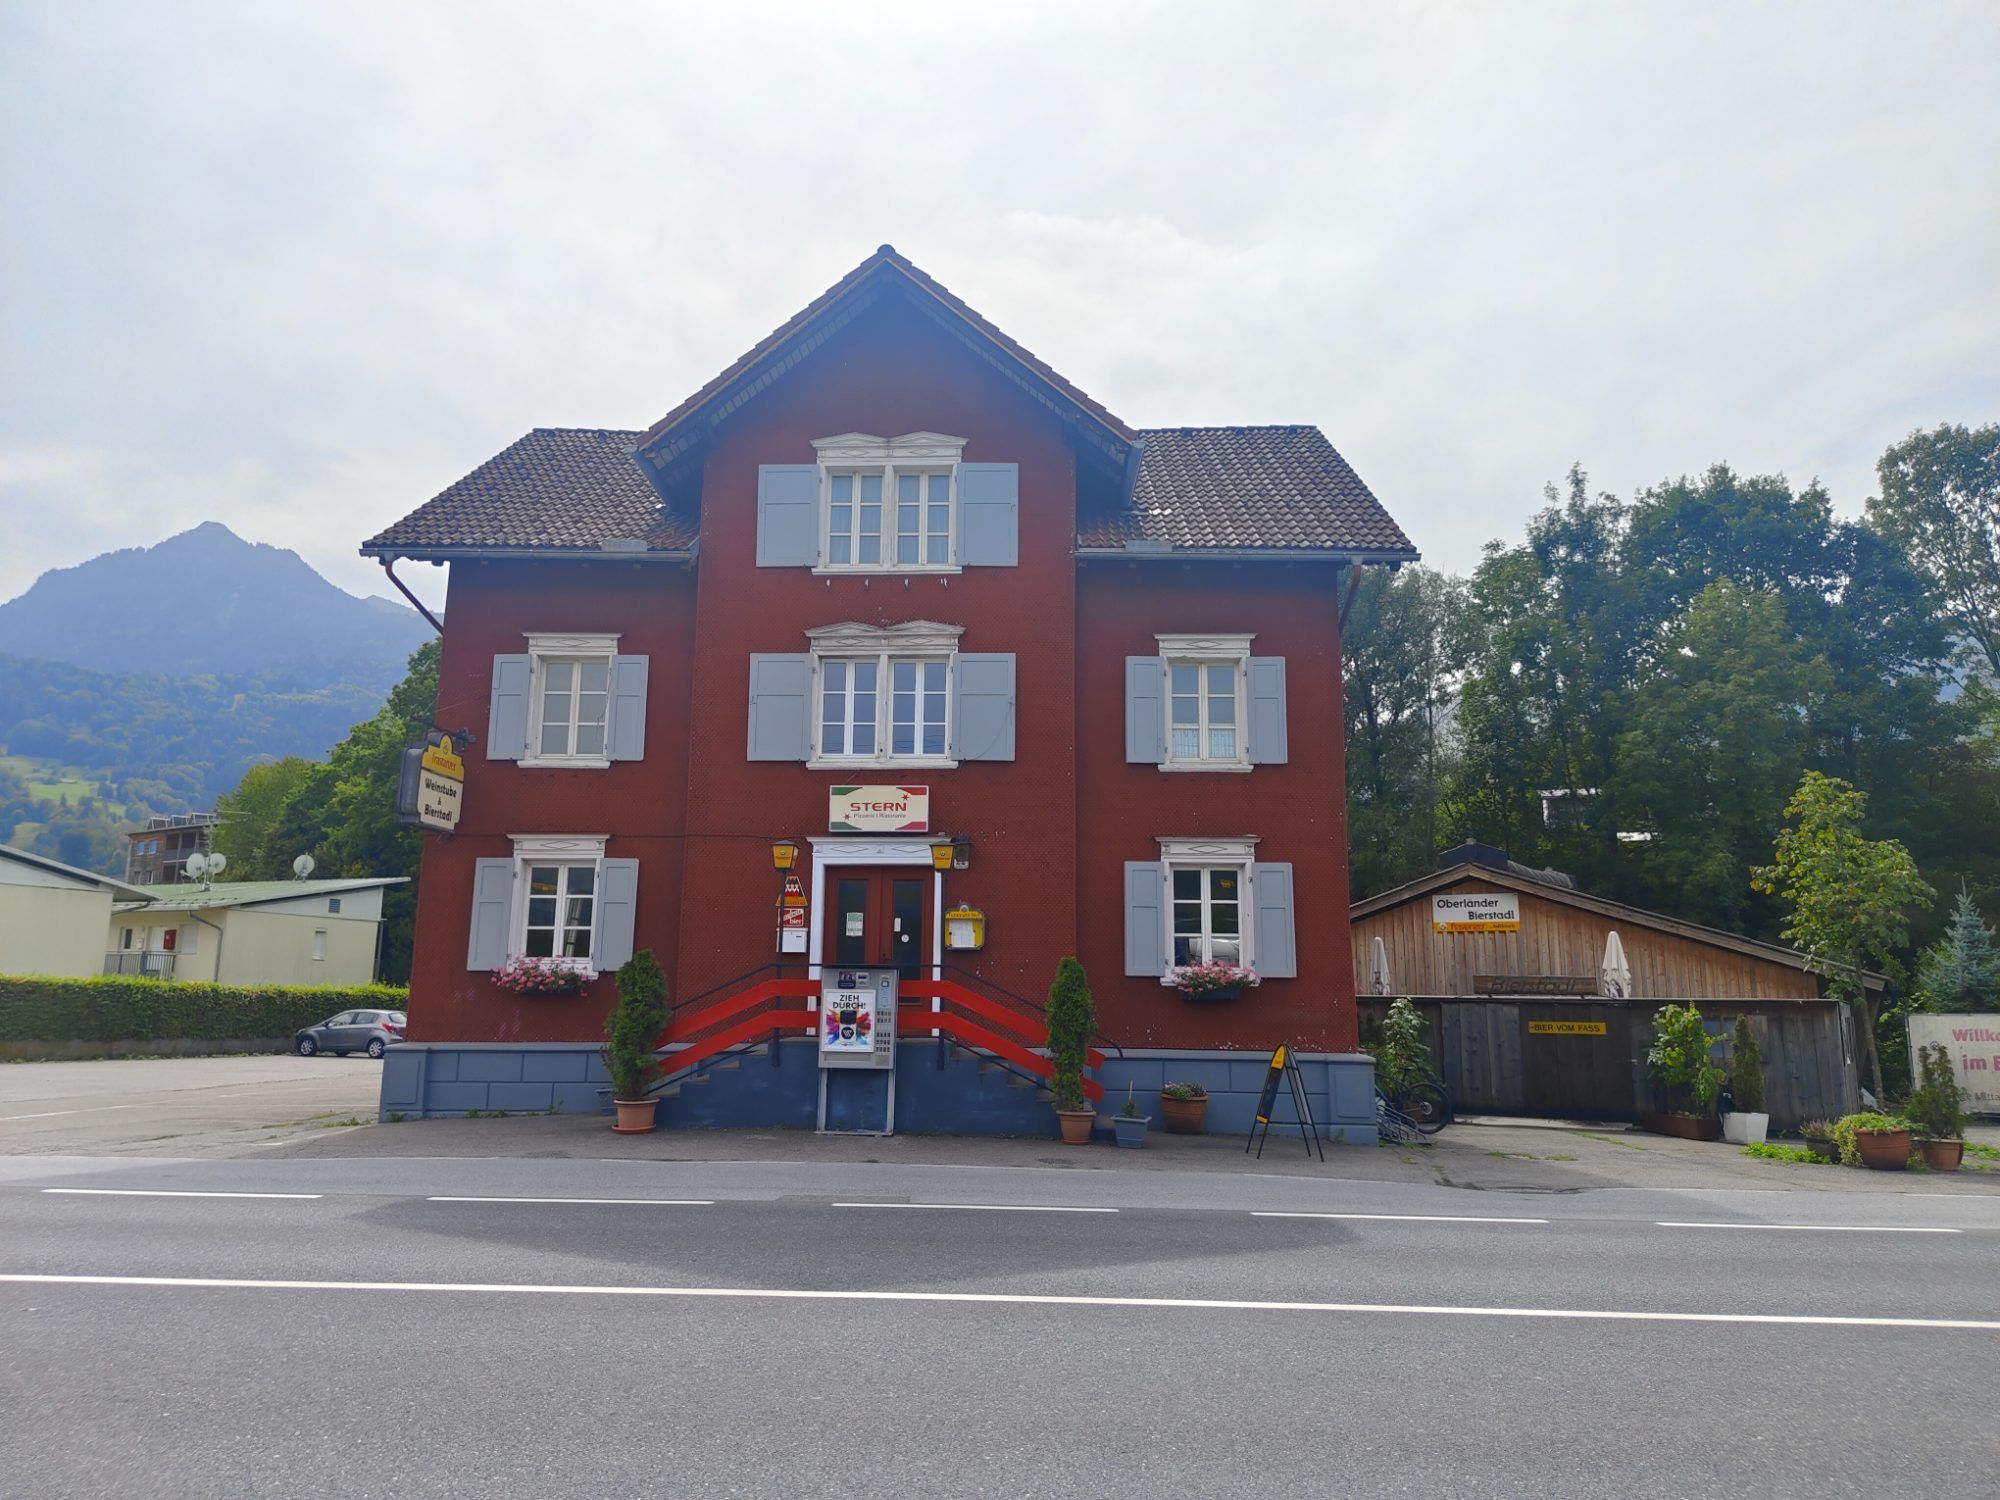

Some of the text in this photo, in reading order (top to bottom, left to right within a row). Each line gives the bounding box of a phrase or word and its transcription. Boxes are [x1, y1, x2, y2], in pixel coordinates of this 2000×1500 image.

[425, 777, 457, 798] Weinstube
[437, 797, 442, 806] &
[850, 802, 907, 812] STERN
[424, 804, 453, 822] Bierstadl
[1437, 898, 1499, 909] Oberländer
[1468, 910, 1515, 920] Bierstadl
[1490, 977, 1577, 993] Bierstadl
[839, 994, 860, 1002] ZIEH
[832, 1002, 866, 1010] DURCH!
[1556, 1024, 1575, 1032] VOM
[1962, 1054, 1988, 1071] im
